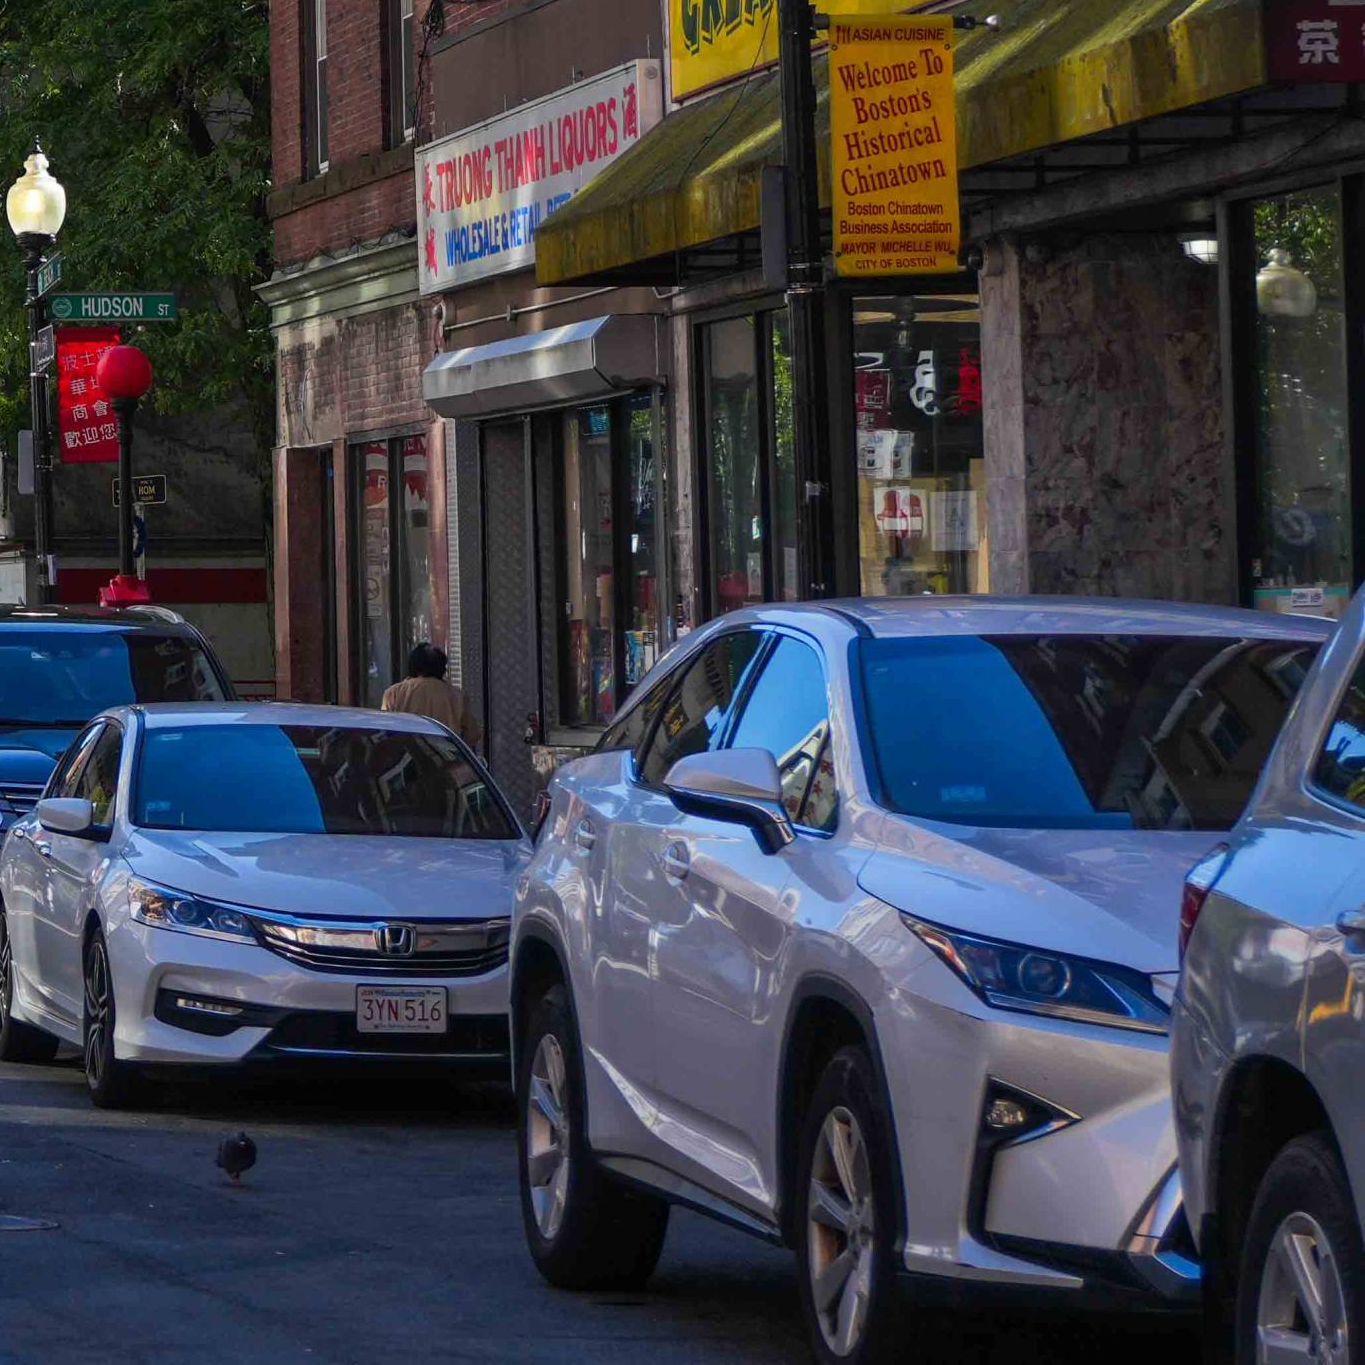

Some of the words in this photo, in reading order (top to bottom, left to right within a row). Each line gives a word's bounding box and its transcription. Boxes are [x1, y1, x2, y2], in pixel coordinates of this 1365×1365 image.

[852, 28, 891, 41] ASIAN
[894, 28, 945, 41] CUISINE
[1296, 18, 1365, 65] 茶
[837, 60, 918, 93] Welcome
[919, 48, 944, 76] To
[852, 87, 932, 124] Boston's
[843, 116, 943, 162] Historical
[436, 144, 493, 213] TRUONG
[494, 121, 547, 195] THANH
[548, 96, 619, 177] LIQUORS
[840, 157, 947, 197] Chinatown
[848, 201, 886, 216] Boston
[887, 201, 944, 216] Chinatown
[840, 220, 889, 235] Business
[891, 220, 952, 235] Association
[445, 213, 501, 268] WHOLESALE
[501, 215, 510, 252] &
[841, 242, 876, 255] MAYOR
[880, 241, 932, 254] MICHELLE
[934, 240, 951, 253] WU
[855, 258, 877, 270] CITY
[880, 258, 894, 269] OF
[895, 257, 937, 268] BOSTON
[81, 297, 143, 317] HUDSON
[157, 303, 170, 317] ST
[71, 400, 109, 422] 商會
[64, 423, 118, 449] 歡迎您
[362, 998, 399, 1022] 3YN
[404, 999, 442, 1022] 516
